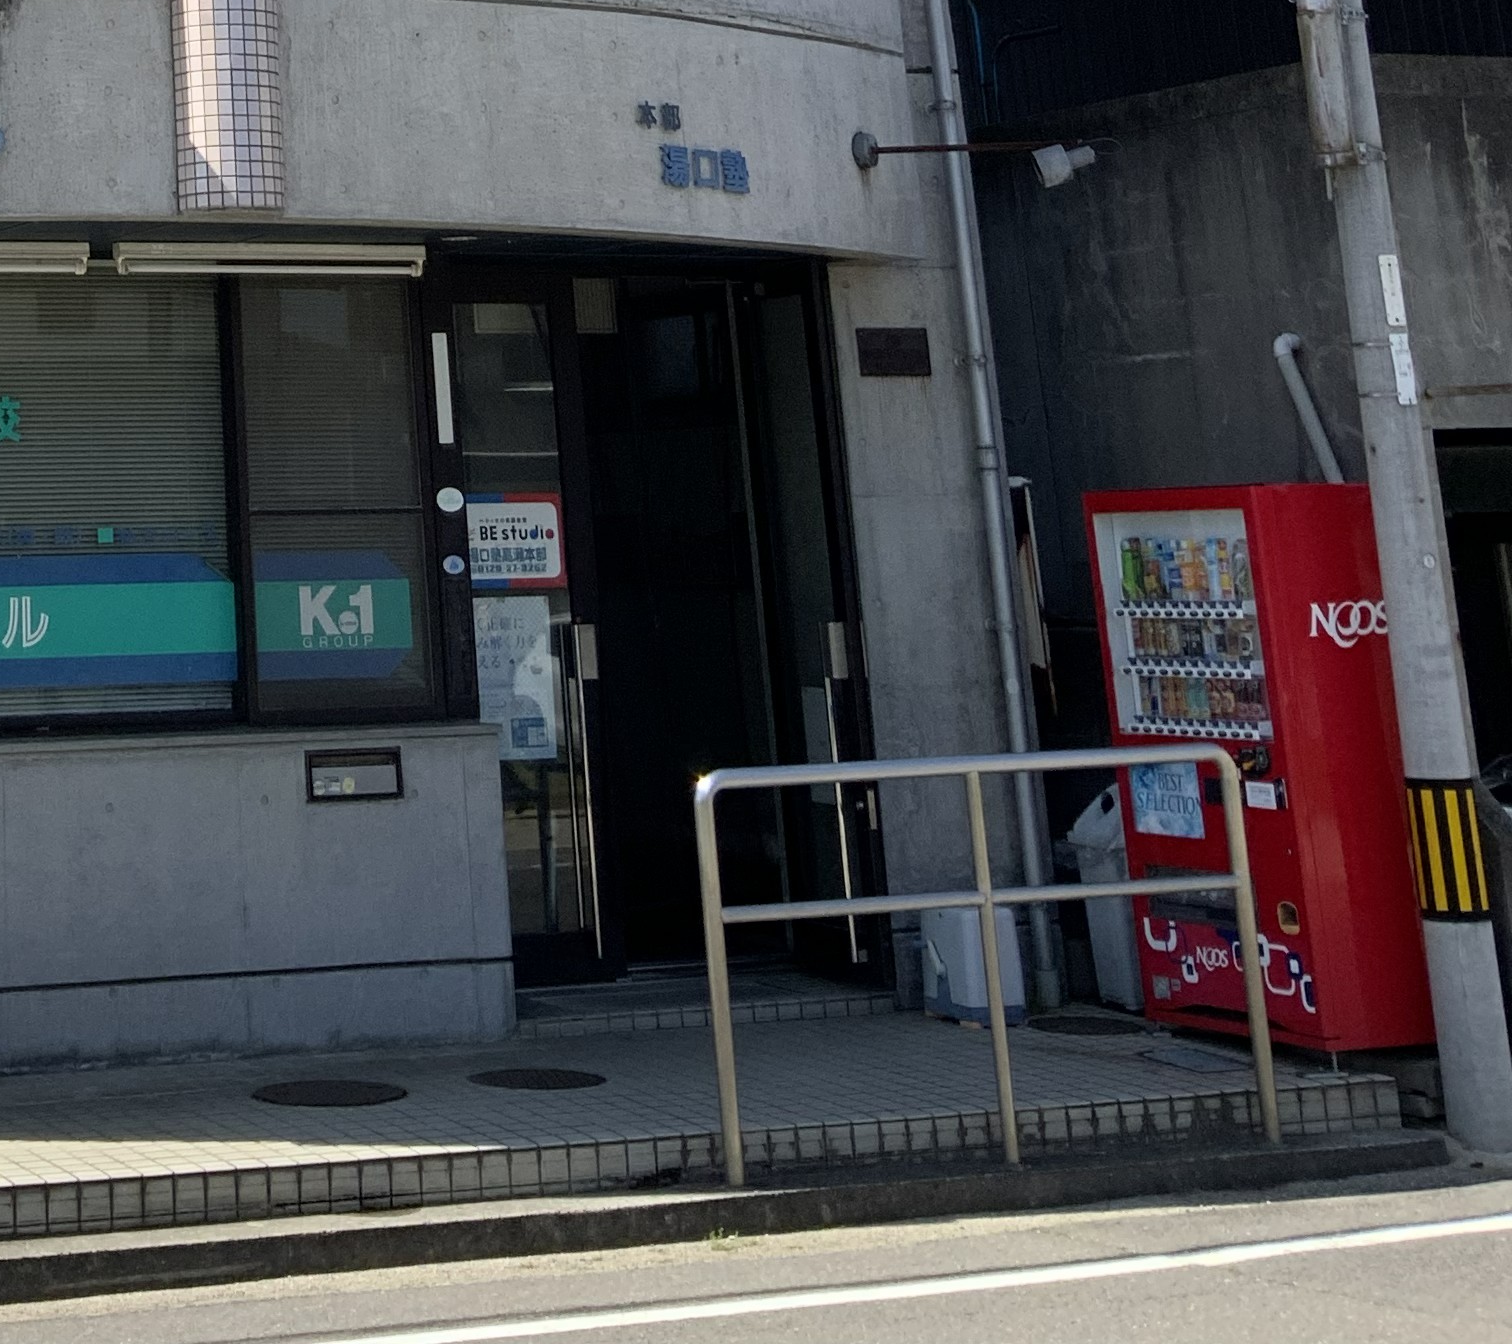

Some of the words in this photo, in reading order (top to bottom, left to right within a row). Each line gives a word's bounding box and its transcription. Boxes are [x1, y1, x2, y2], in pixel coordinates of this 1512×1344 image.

[635, 100, 681, 132] 本部
[659, 143, 751, 194] 湯口塾
[479, 525, 498, 541] BE
[501, 524, 555, 541] studio
[302, 634, 375, 649] GROUP
[1157, 772, 1184, 793] BEST
